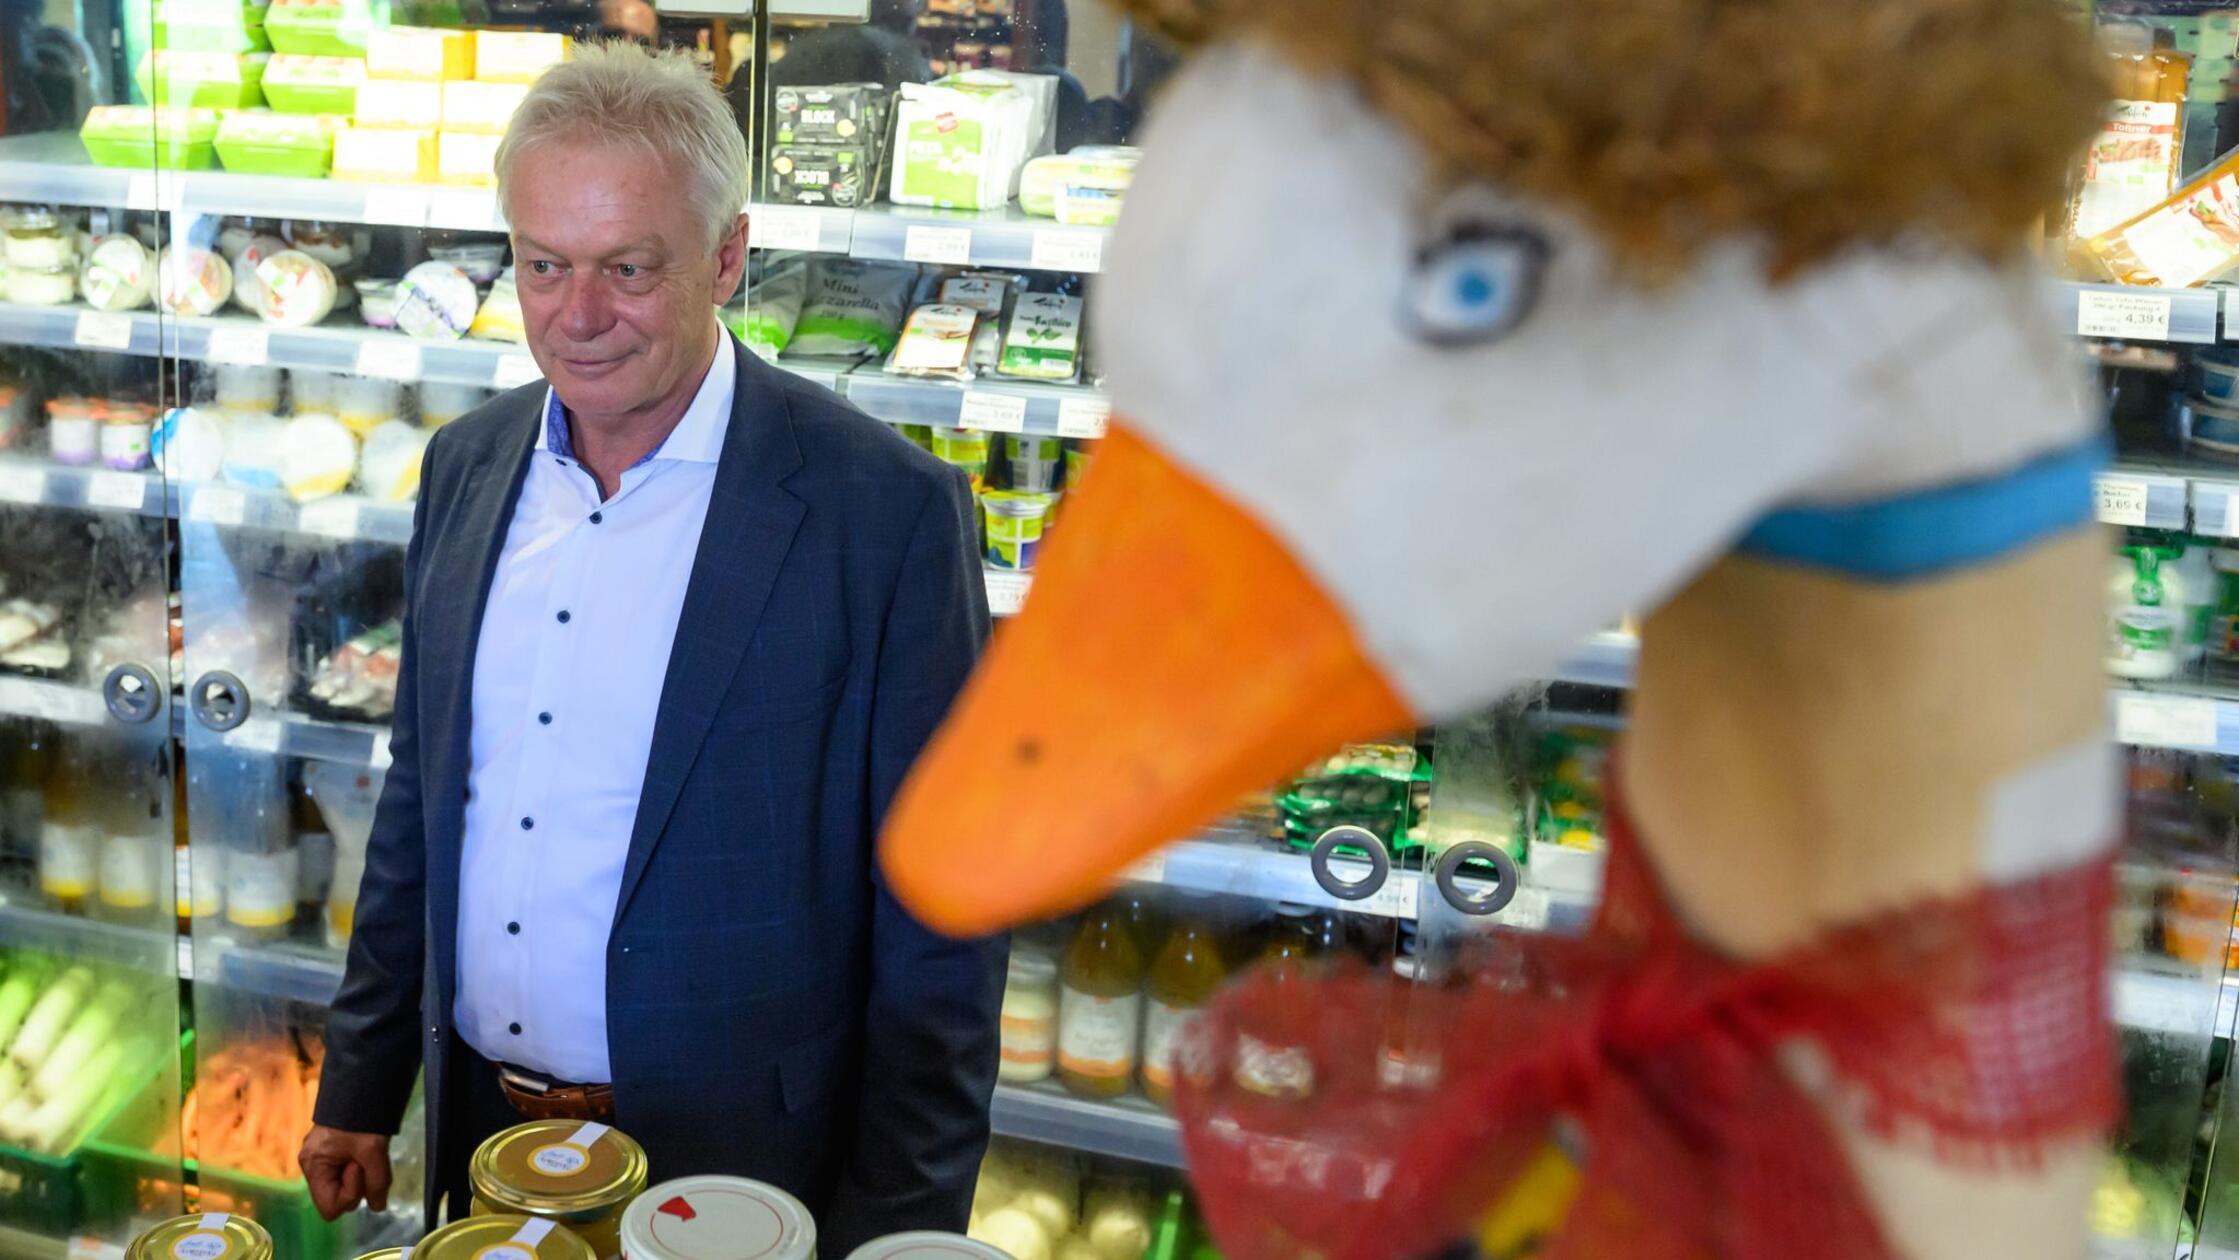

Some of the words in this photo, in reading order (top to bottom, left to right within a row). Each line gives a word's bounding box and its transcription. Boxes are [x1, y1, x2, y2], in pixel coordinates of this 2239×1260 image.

[800, 109, 836, 124] BLOCK
[823, 277, 860, 294] Mini
[815, 295, 880, 312] zzarella
[2125, 313, 2154, 325] 4,39
[2157, 315, 2166, 326] €
